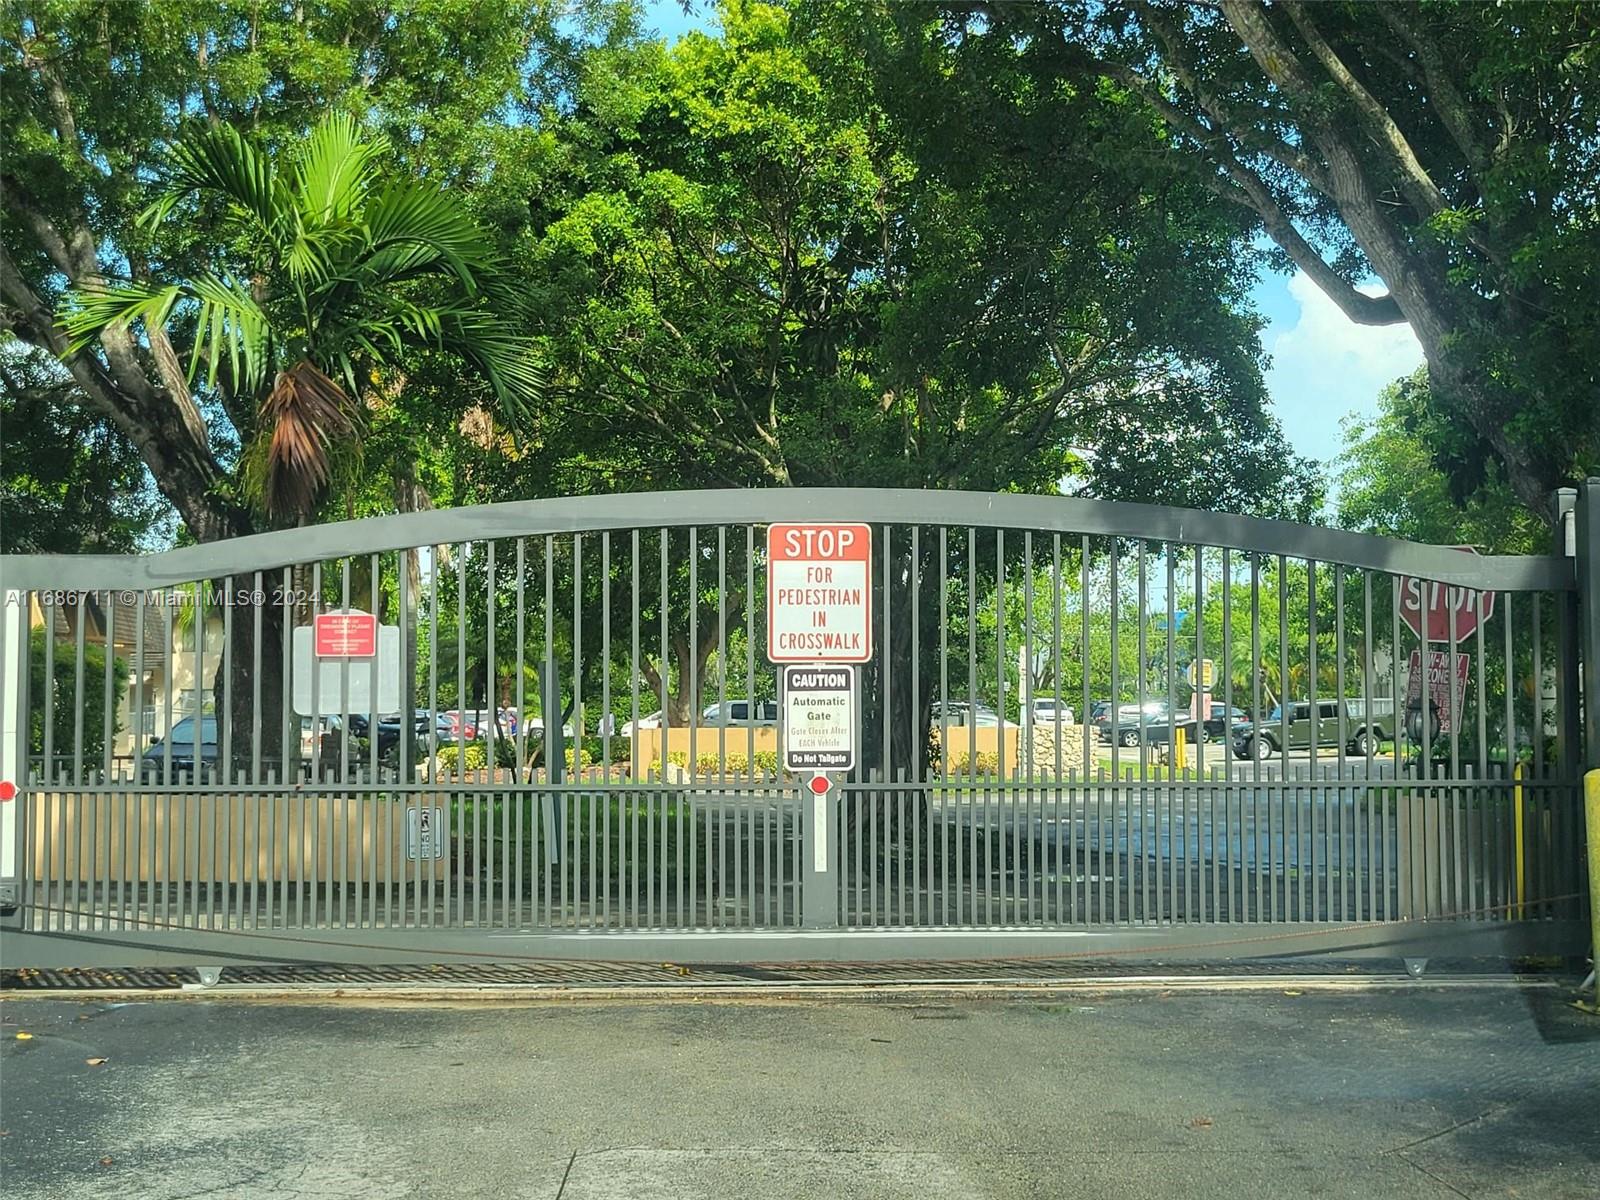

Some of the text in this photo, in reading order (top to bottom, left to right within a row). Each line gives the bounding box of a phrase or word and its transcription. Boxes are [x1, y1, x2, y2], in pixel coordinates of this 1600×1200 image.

[784, 529, 854, 558] STOP
[807, 567, 832, 583] FOR
[778, 589, 861, 605] PEDESTRIAN
[812, 611, 826, 627] IN
[779, 633, 860, 649] CROSSWALK
[792, 674, 846, 687] CAUTION
[793, 696, 846, 706] Automatic
[807, 711, 831, 721] Gate
[791, 727, 847, 735] Gate Closes After
[799, 739, 840, 747] EACH Vehicle
[792, 754, 847, 764] Do Not Tailgate
